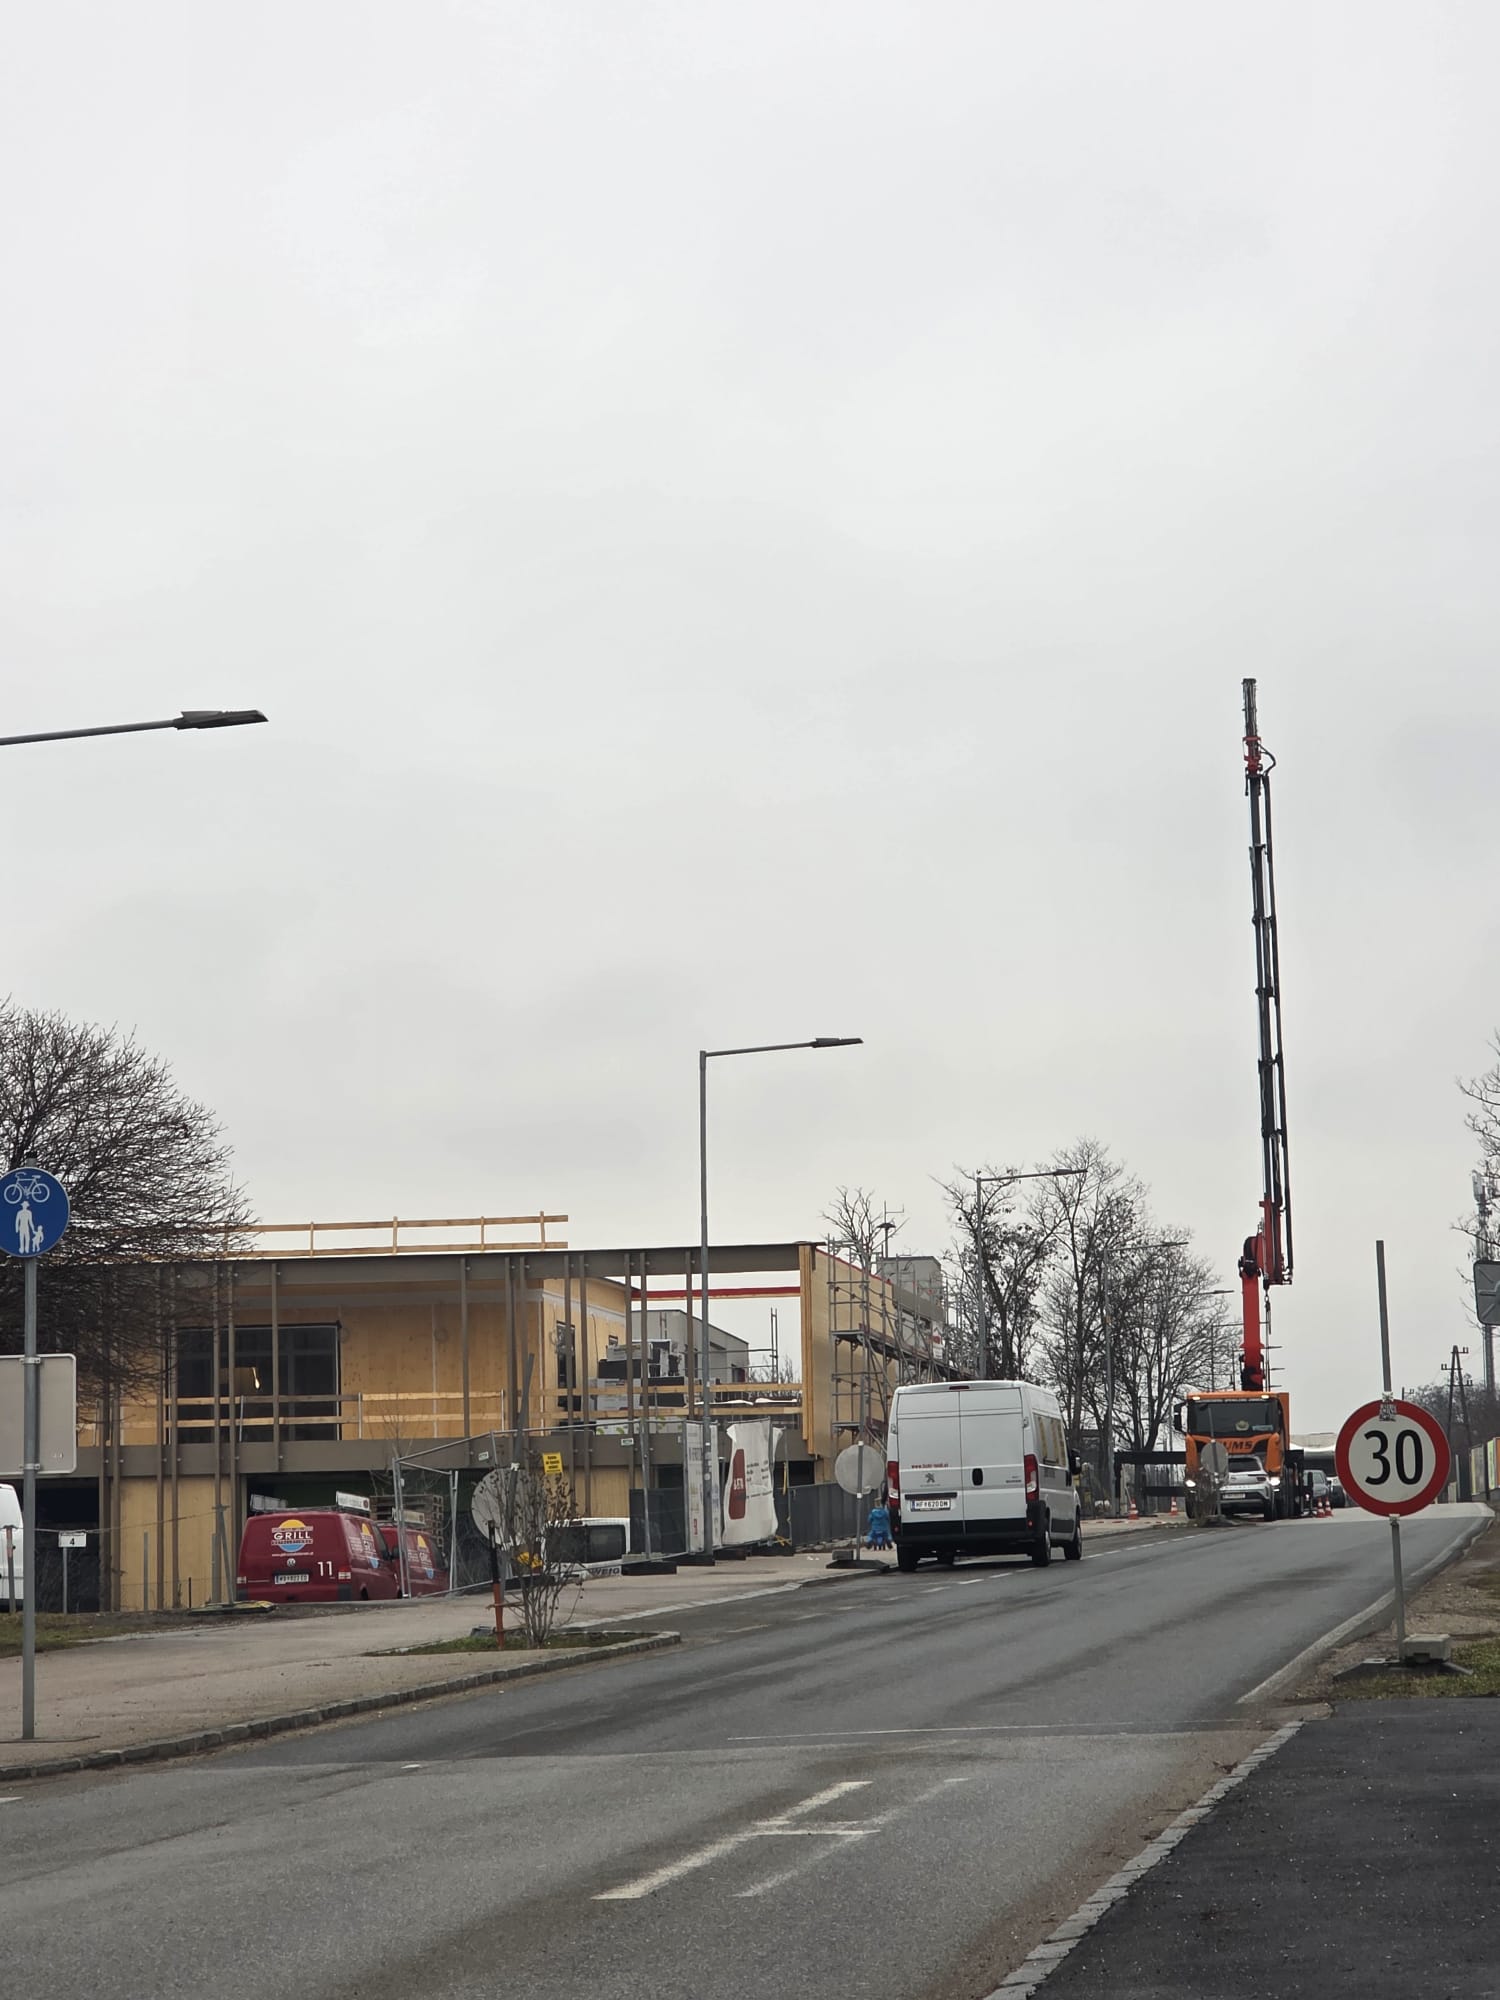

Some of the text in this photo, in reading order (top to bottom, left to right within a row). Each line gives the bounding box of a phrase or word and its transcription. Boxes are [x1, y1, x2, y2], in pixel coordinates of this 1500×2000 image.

[1364, 1429, 1424, 1485] 30
[273, 1531, 311, 1539] GRILL
[69, 1537, 75, 1546] 4
[317, 1561, 333, 1577] 11
